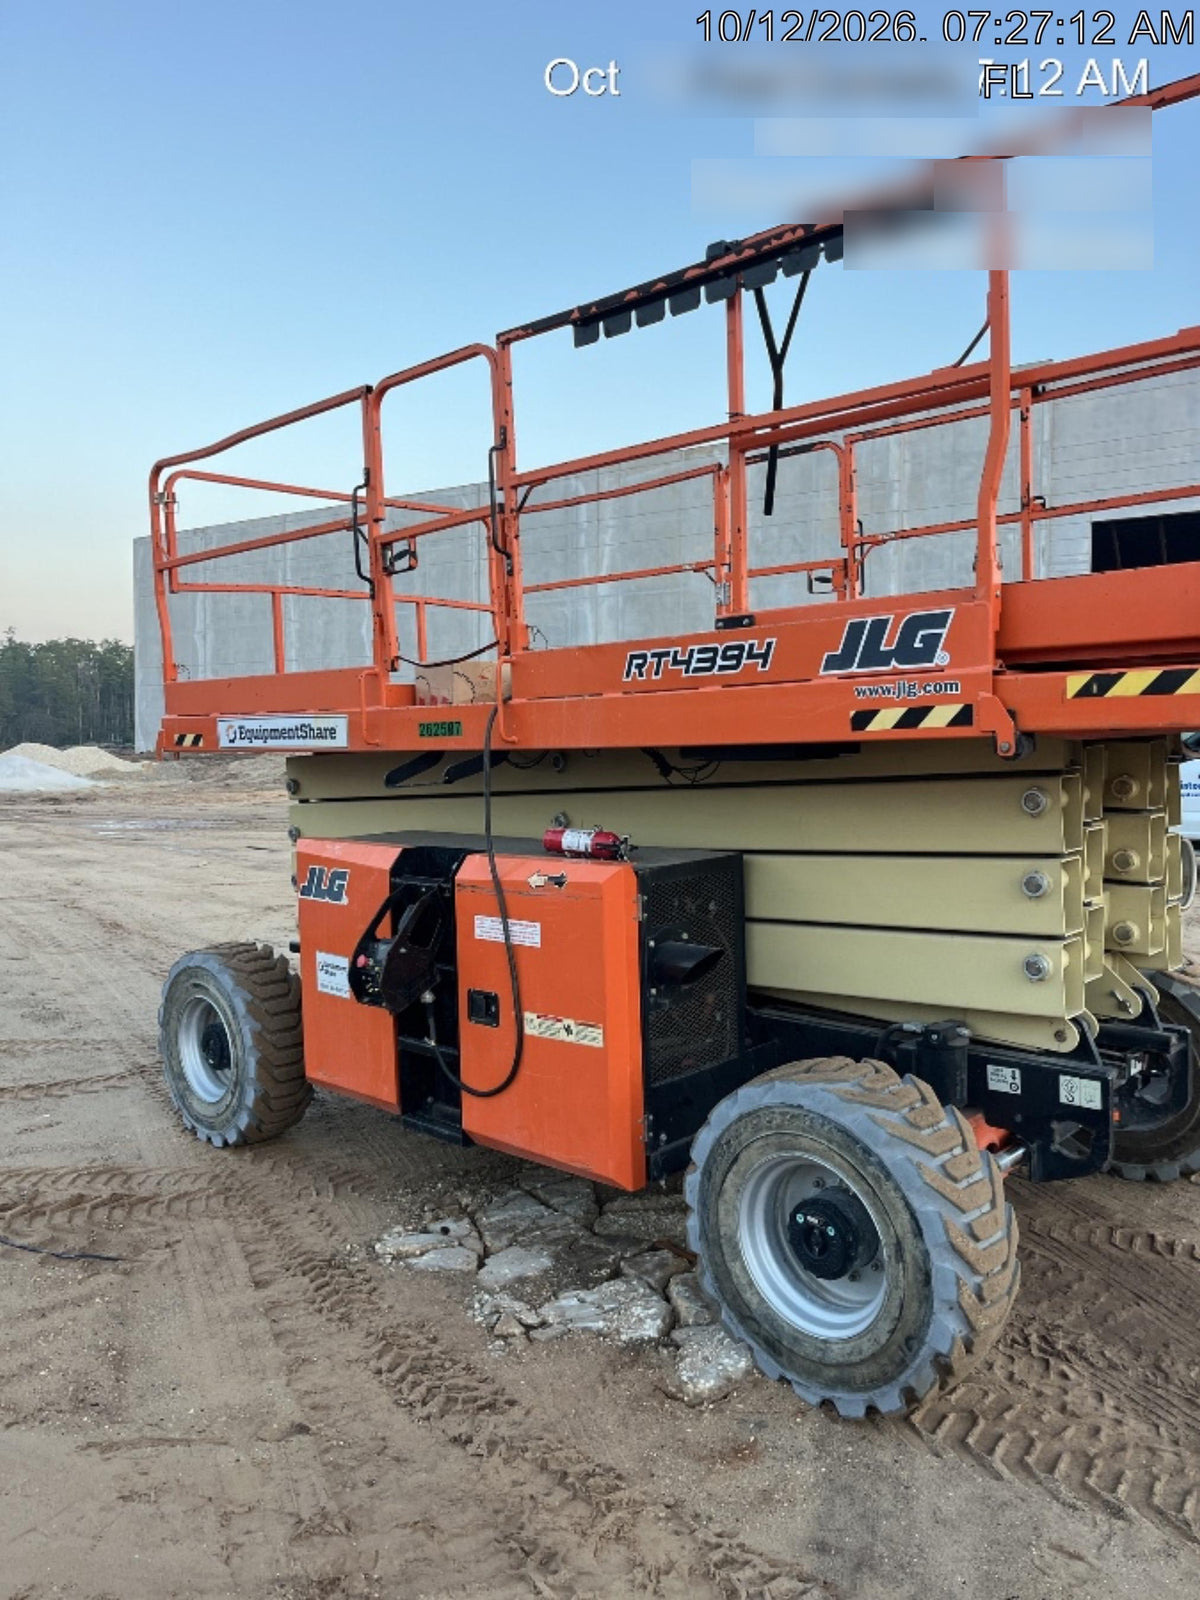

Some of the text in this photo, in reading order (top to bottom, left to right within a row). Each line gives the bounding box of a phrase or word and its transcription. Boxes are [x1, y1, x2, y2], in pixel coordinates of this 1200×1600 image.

[622, 638, 777, 681] RT4394
[819, 608, 955, 675] JLG
[854, 679, 961, 698] www.jlg.com
[237, 723, 337, 744] EquipmentShare
[299, 865, 350, 904] JLG
